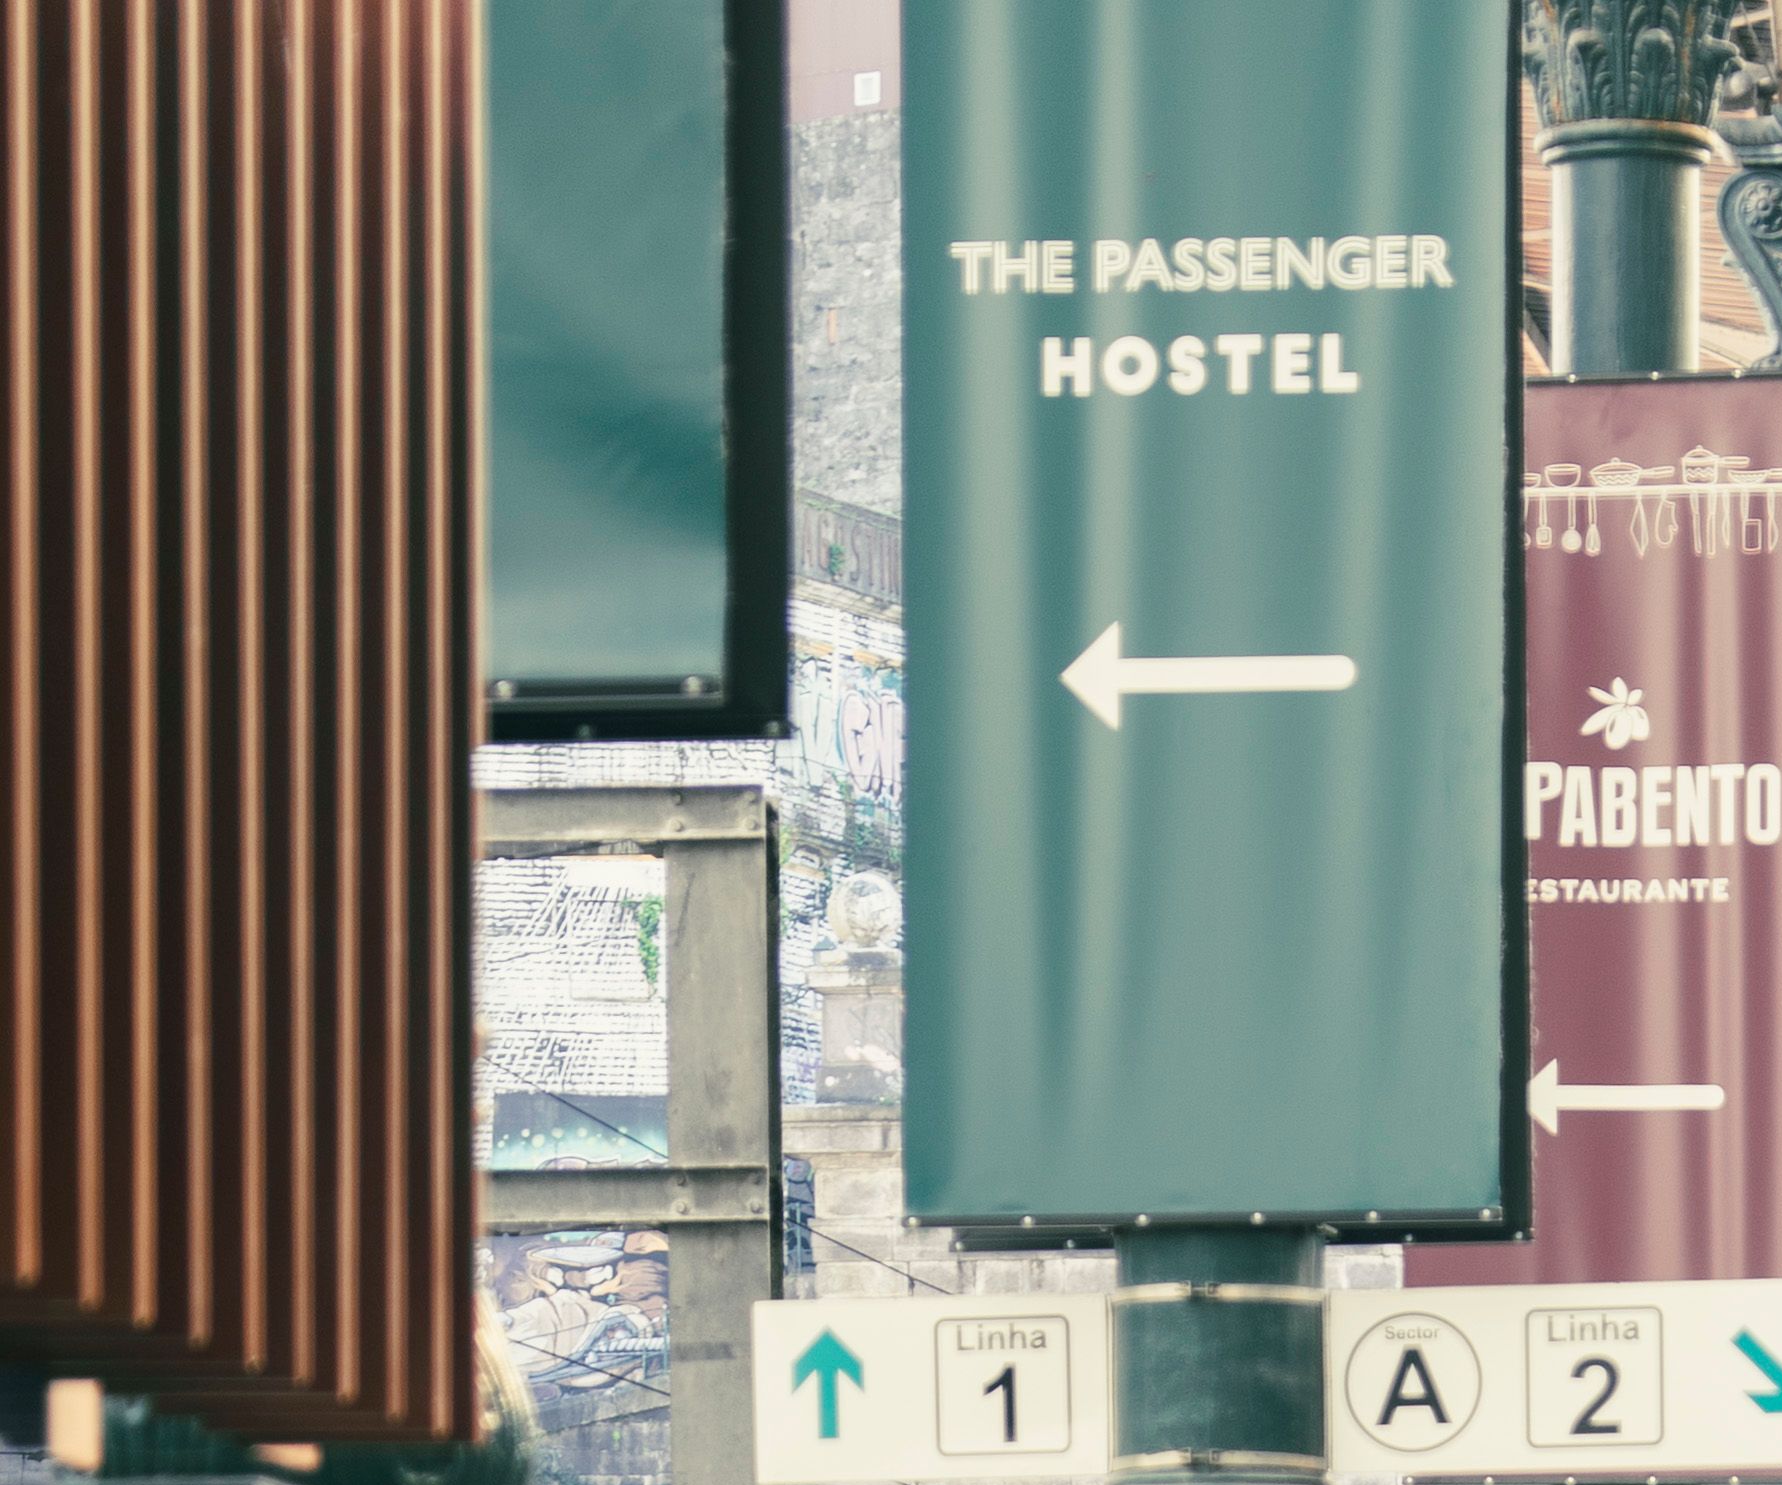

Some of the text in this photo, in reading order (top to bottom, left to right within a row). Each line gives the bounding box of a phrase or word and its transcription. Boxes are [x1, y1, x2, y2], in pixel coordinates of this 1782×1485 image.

[949, 234, 1455, 294] THE PASSENGER
[1038, 333, 1360, 396] HOSTEL
[956, 1323, 1047, 1351] Linha
[1384, 1314, 1640, 1343] Sector Linha
[983, 1362, 1018, 1443] 1
[1376, 1349, 1621, 1435] A 2
